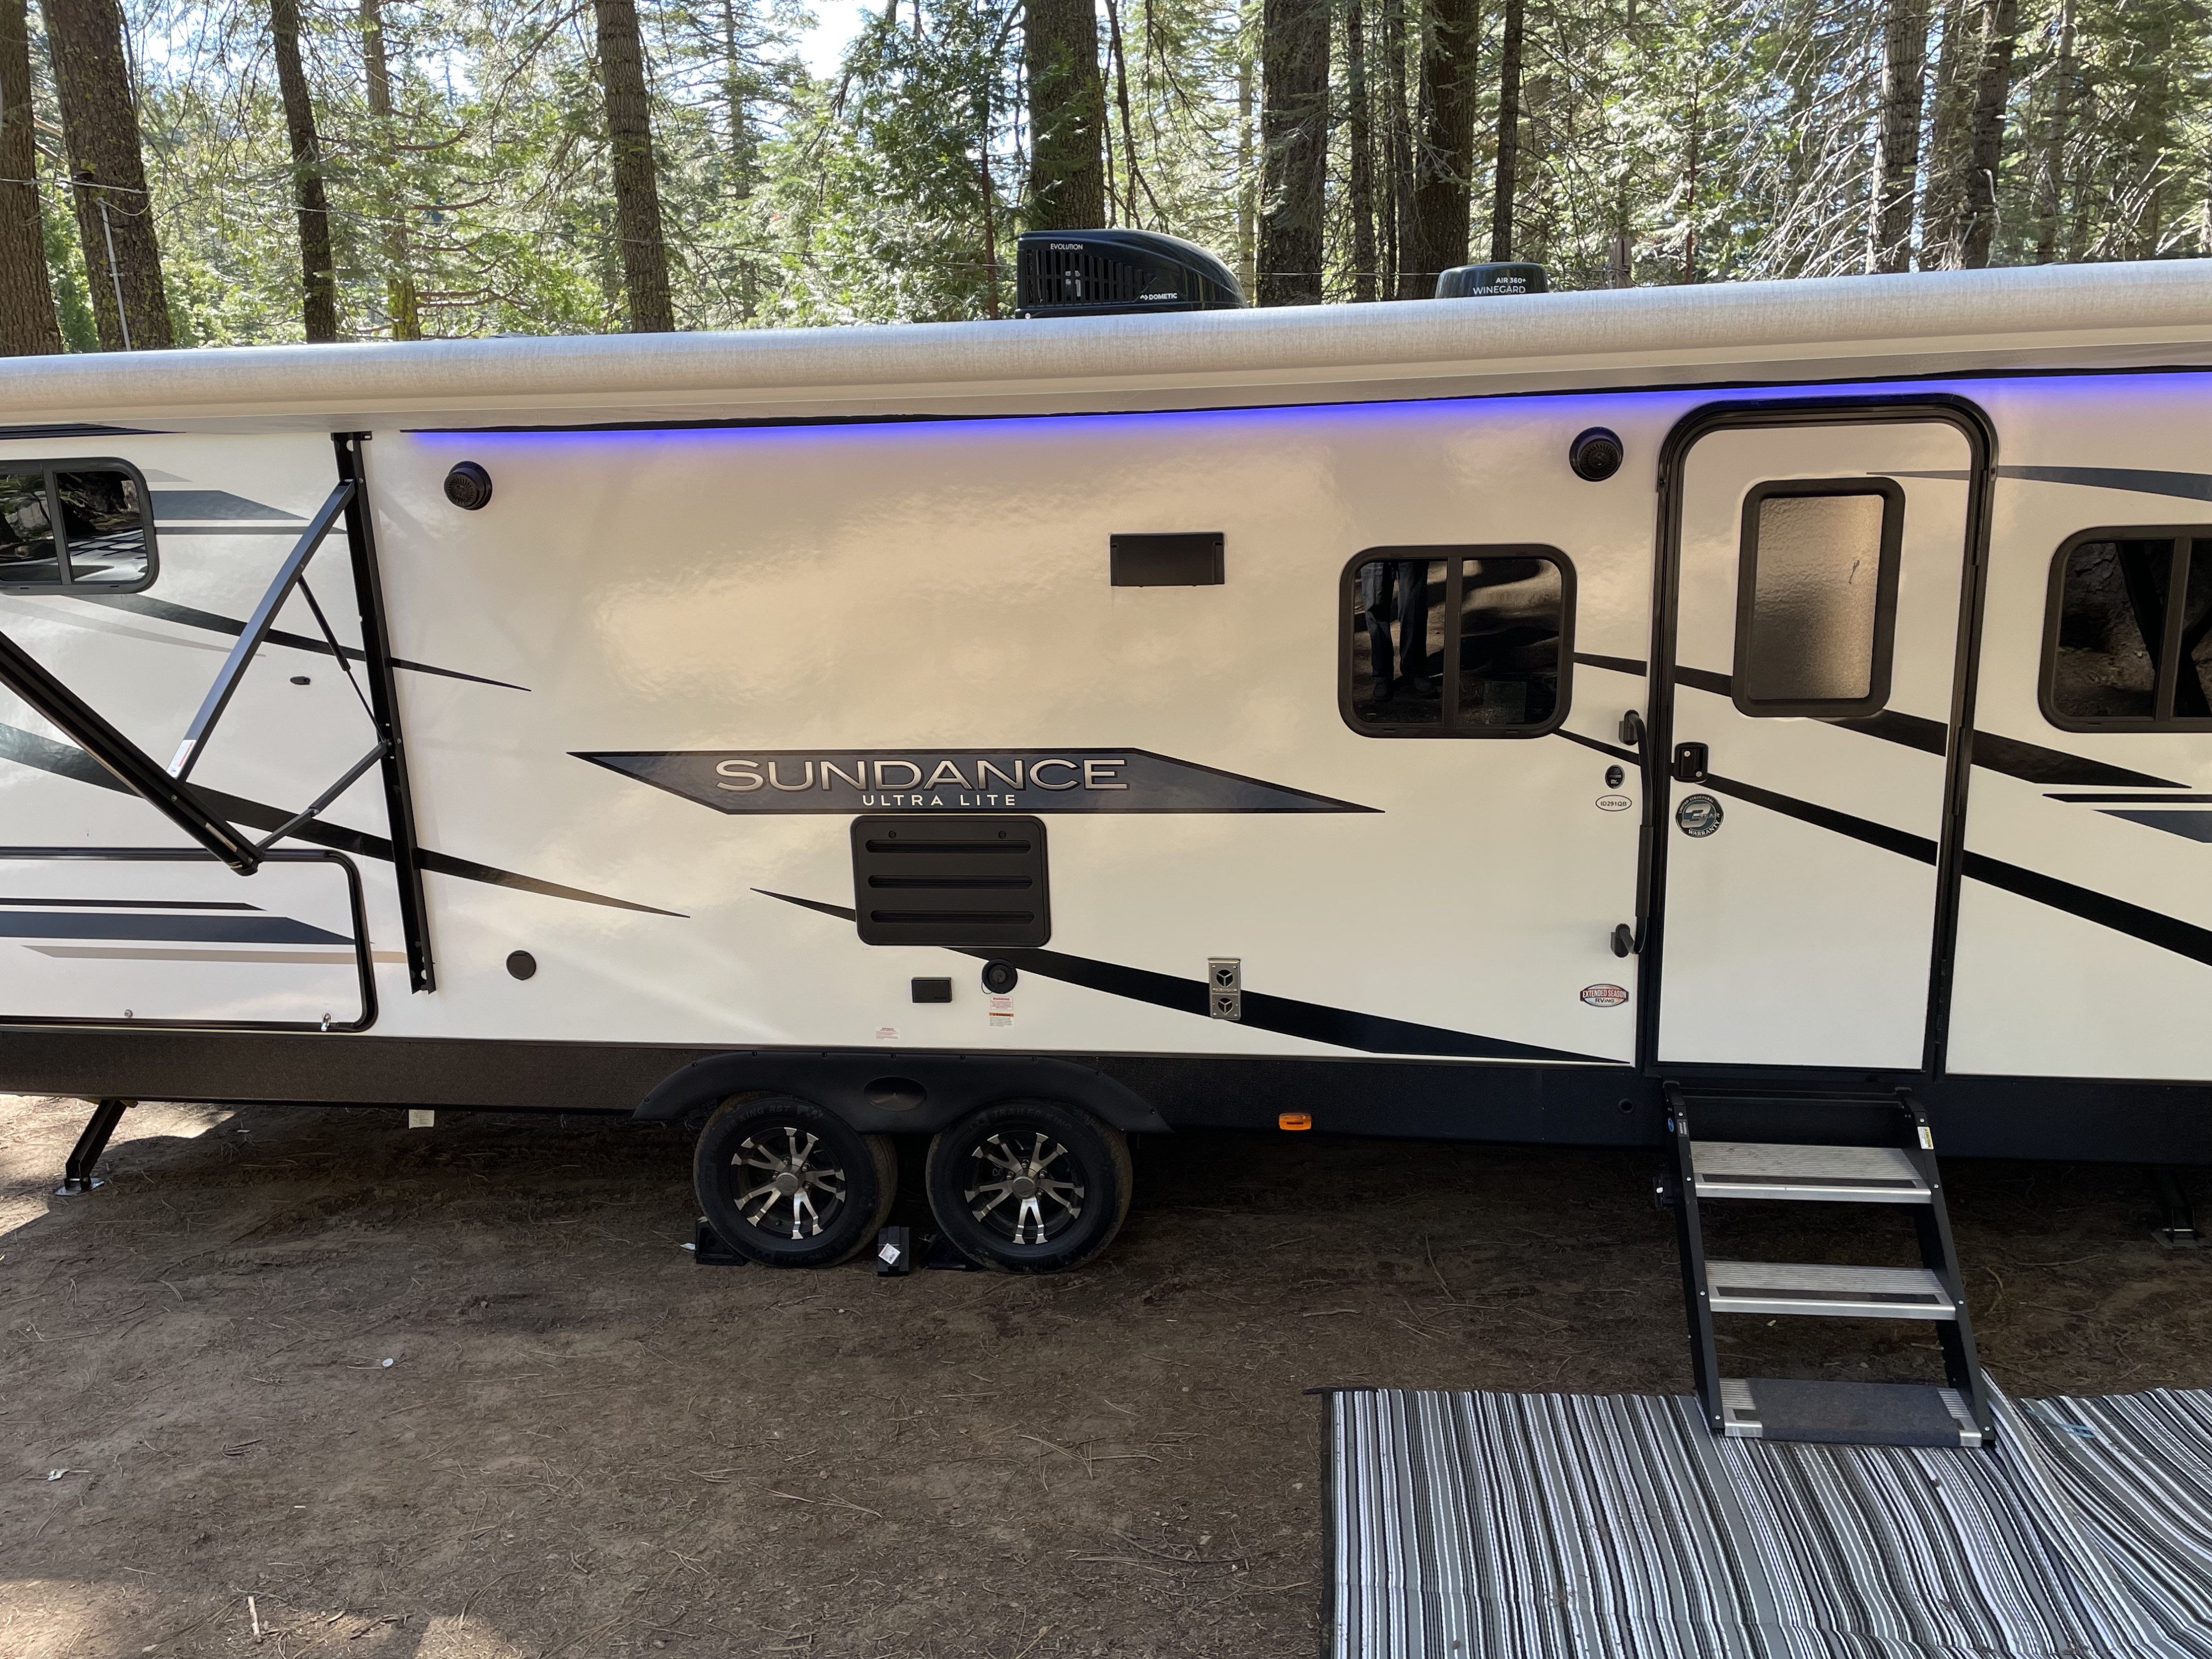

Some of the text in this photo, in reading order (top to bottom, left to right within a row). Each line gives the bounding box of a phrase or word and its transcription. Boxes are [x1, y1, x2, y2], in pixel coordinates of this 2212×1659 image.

[1473, 285, 1526, 295] WINEGARD
[715, 759, 1129, 791] SUNDANCE
[862, 795, 1015, 806] ULTRA LITE
[1688, 820, 1720, 836] WARRANTY
[1582, 989, 1626, 998] EXTENDED SEASON
